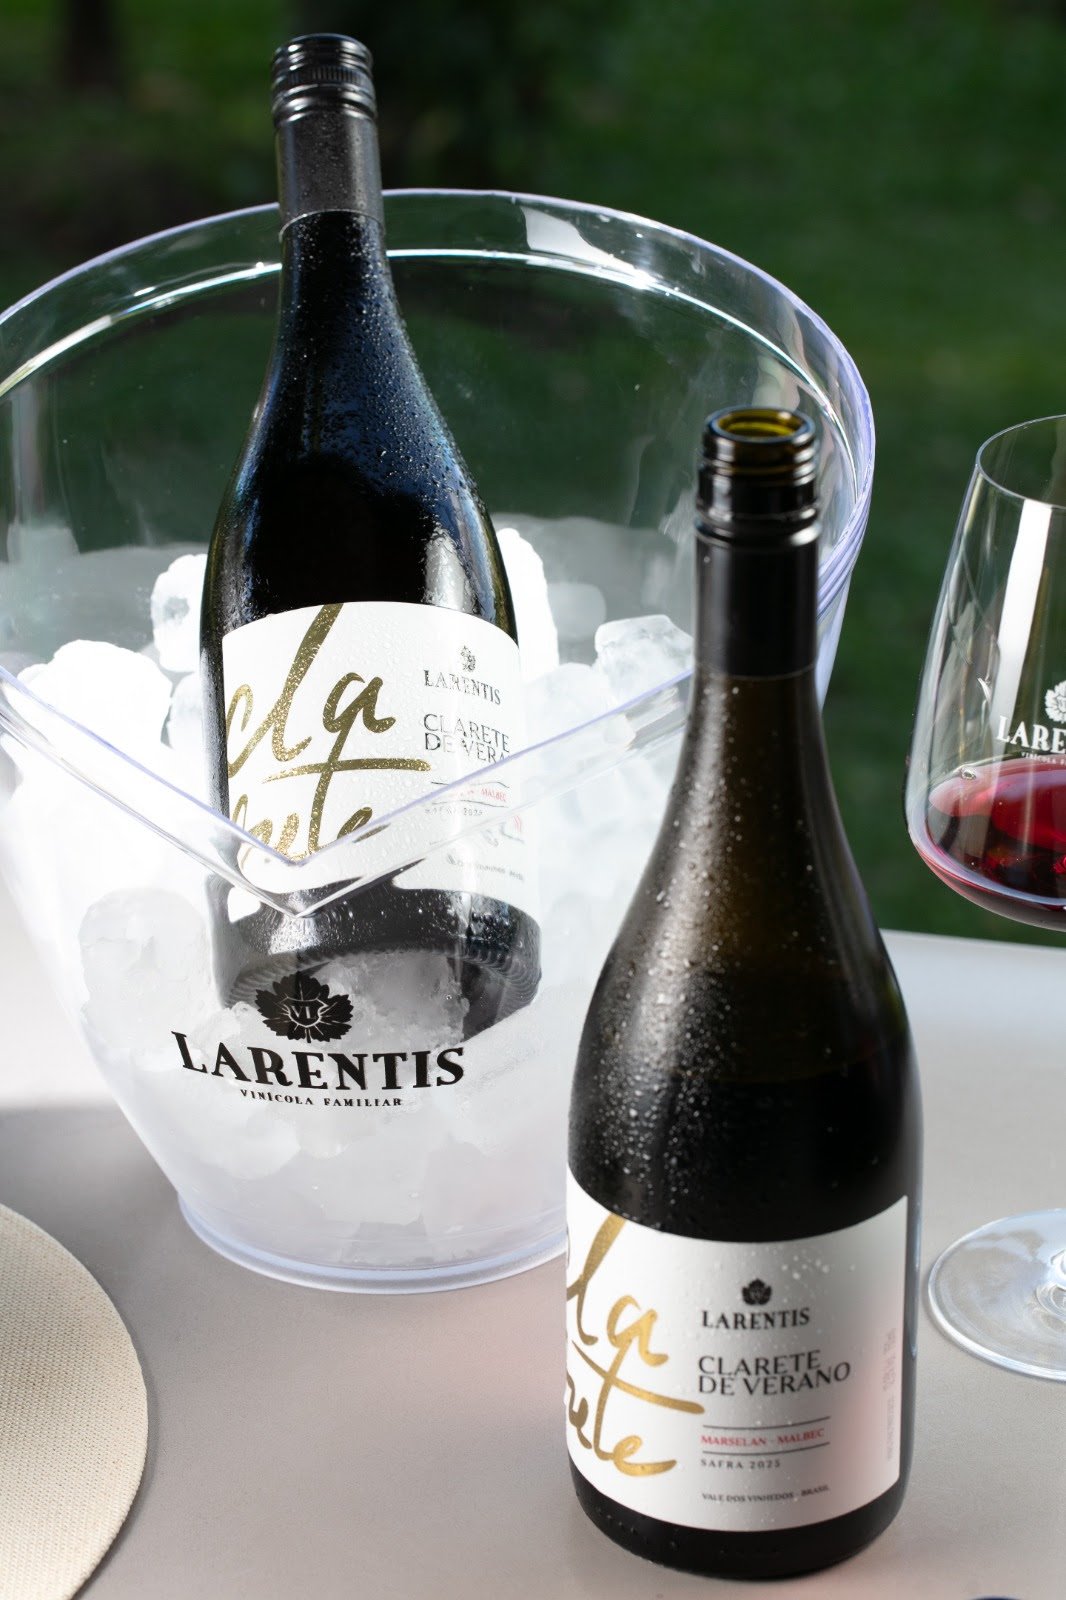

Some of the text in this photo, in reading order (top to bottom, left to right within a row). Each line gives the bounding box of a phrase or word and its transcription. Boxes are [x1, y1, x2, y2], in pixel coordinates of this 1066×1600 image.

[423, 669, 501, 706] LARENTIS
[423, 713, 510, 753] CLARETE
[424, 732, 511, 764] DE VER
[996, 715, 1066, 754] LARE
[171, 1030, 464, 1091] LARENTIS
[323, 1097, 403, 1107] FAMILIAR
[701, 1307, 811, 1331] LARENTIS
[698, 1349, 822, 1377] CLARETE
[698, 1361, 852, 1397] DE VERANO
[701, 1428, 826, 1448] MARSELAN MALBEC
[700, 1459, 782, 1470] SAFRA 2025
[701, 1492, 724, 1501] VALE
[726, 1494, 746, 1503] DOS
[747, 1491, 794, 1502] VINHEDOS
